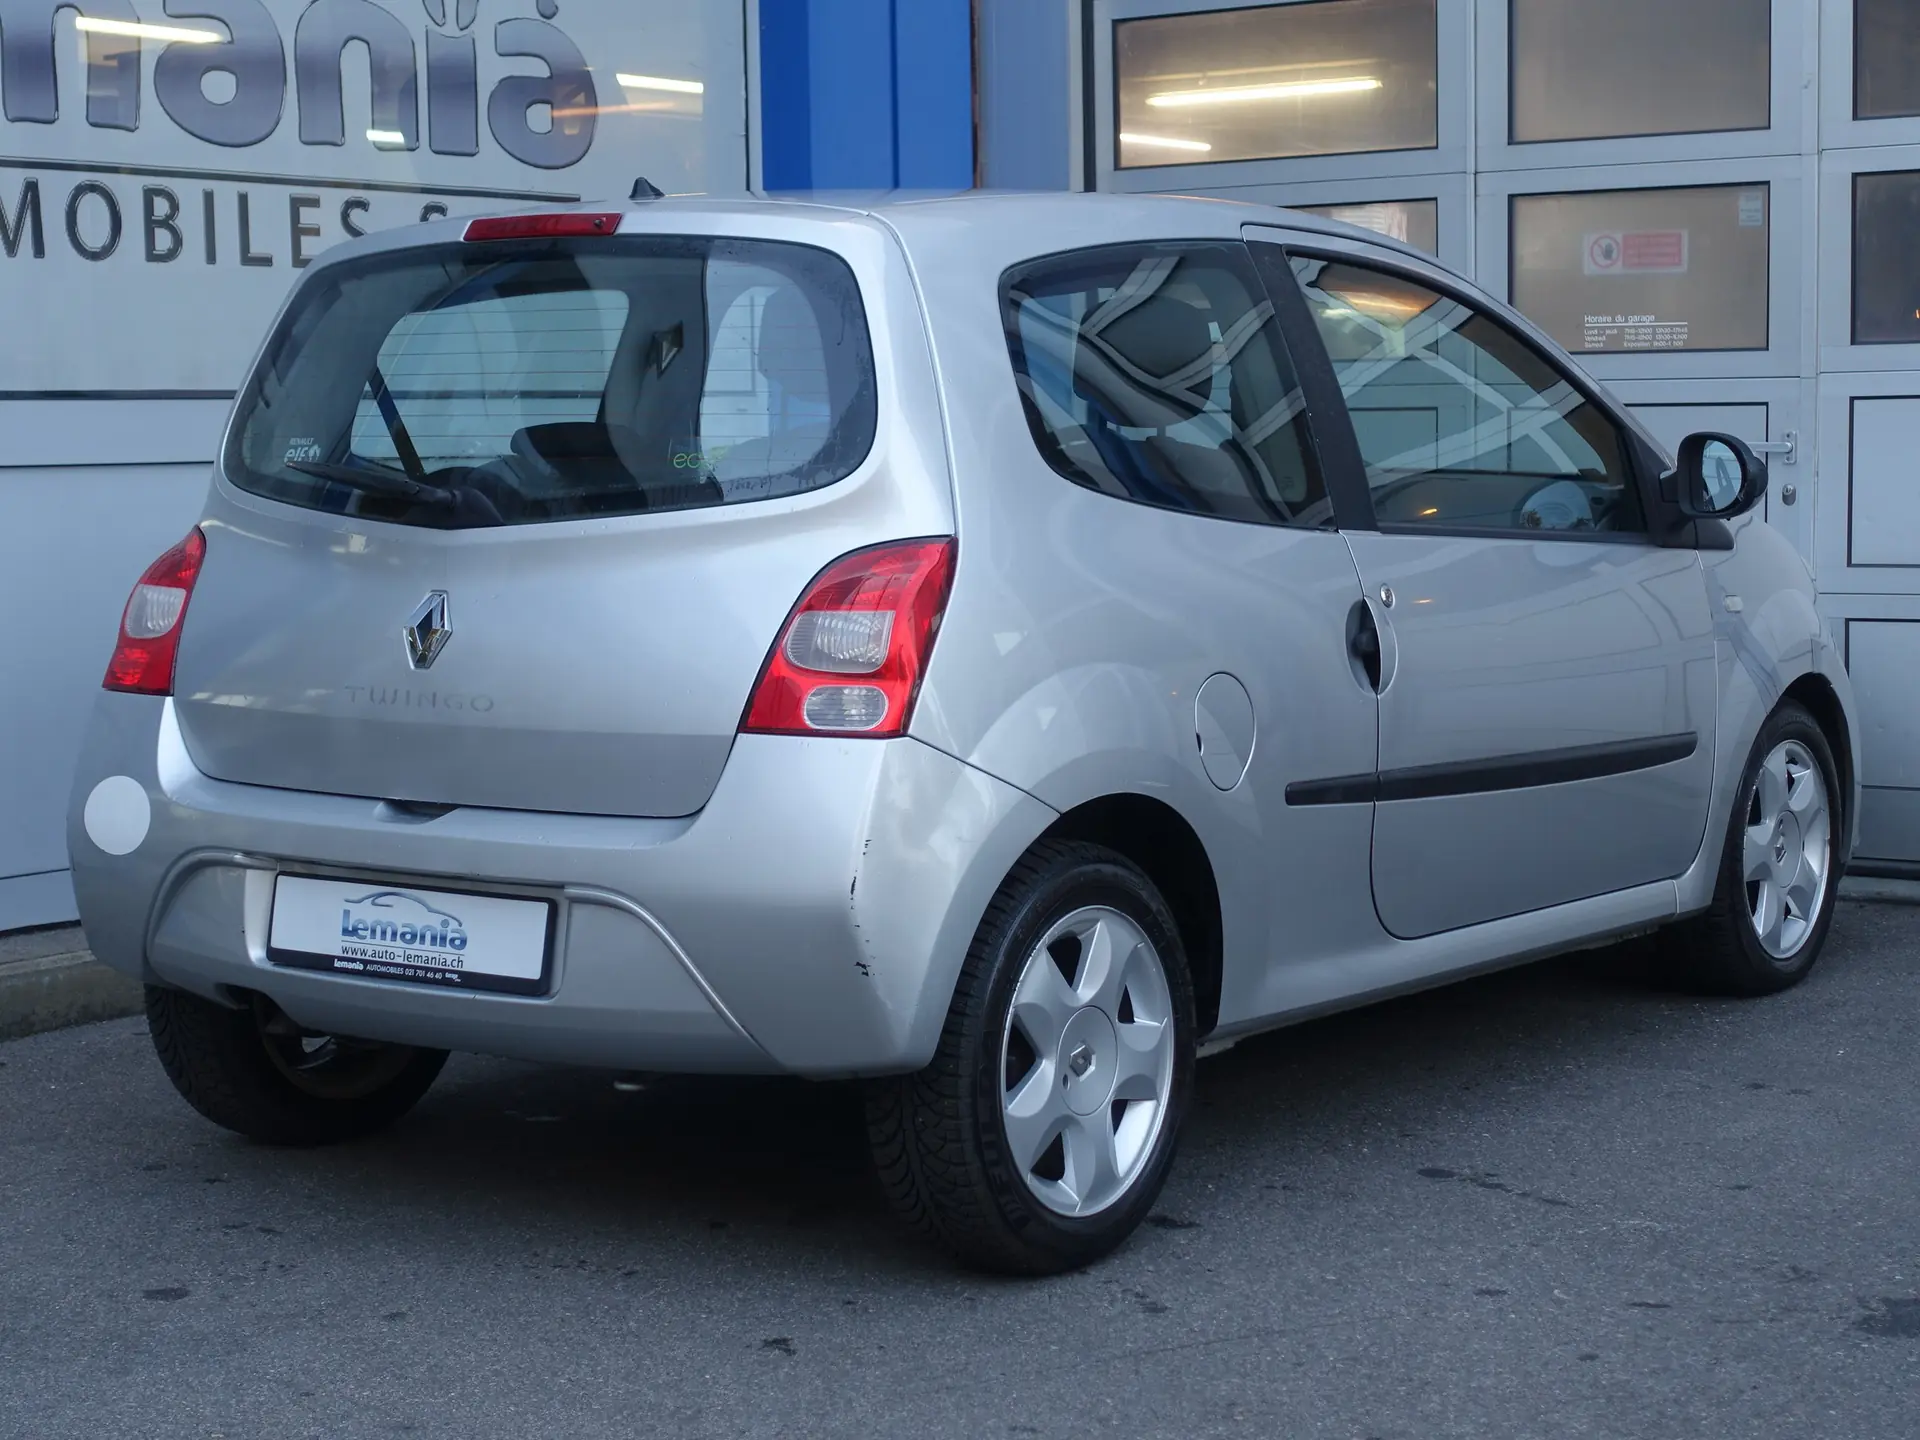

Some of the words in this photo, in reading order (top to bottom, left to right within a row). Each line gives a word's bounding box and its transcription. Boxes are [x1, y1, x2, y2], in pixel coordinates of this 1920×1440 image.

[1584, 314, 1612, 323] Horaire
[1615, 314, 1625, 323] du
[1627, 315, 1655, 324] garage
[344, 685, 495, 712] TWINGO
[341, 945, 464, 969] www.auto-lemania.ch
[366, 963, 404, 975] AUTOMOBILES
[404, 968, 415, 976] 021
[415, 969, 426, 977] 701
